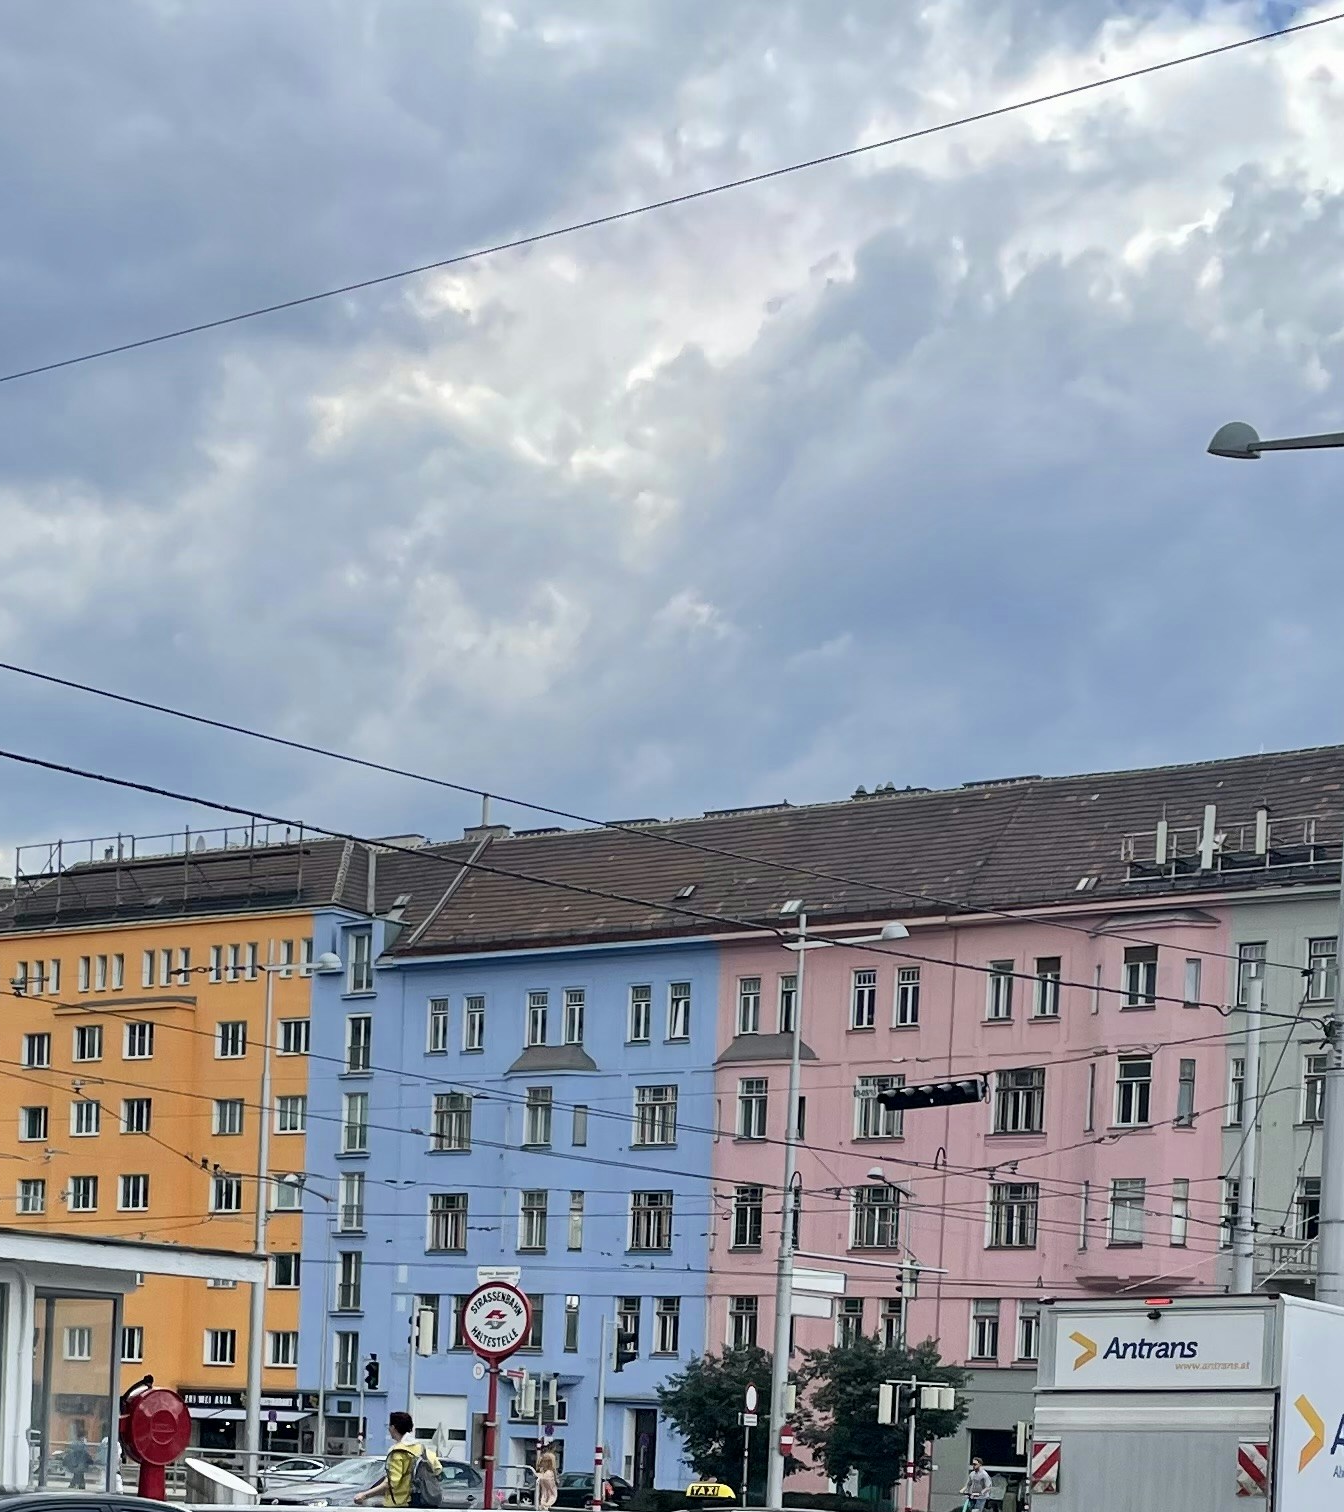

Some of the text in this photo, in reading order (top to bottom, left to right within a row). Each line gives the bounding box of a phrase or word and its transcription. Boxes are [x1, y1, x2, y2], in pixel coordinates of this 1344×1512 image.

[470, 1290, 523, 1317] STRASSENBAHN
[471, 1325, 519, 1348] HALTESTELLE
[1103, 1336, 1199, 1360] Antrans
[1175, 1361, 1250, 1371] www.antrans.at
[691, 1485, 720, 1497] TAXI
